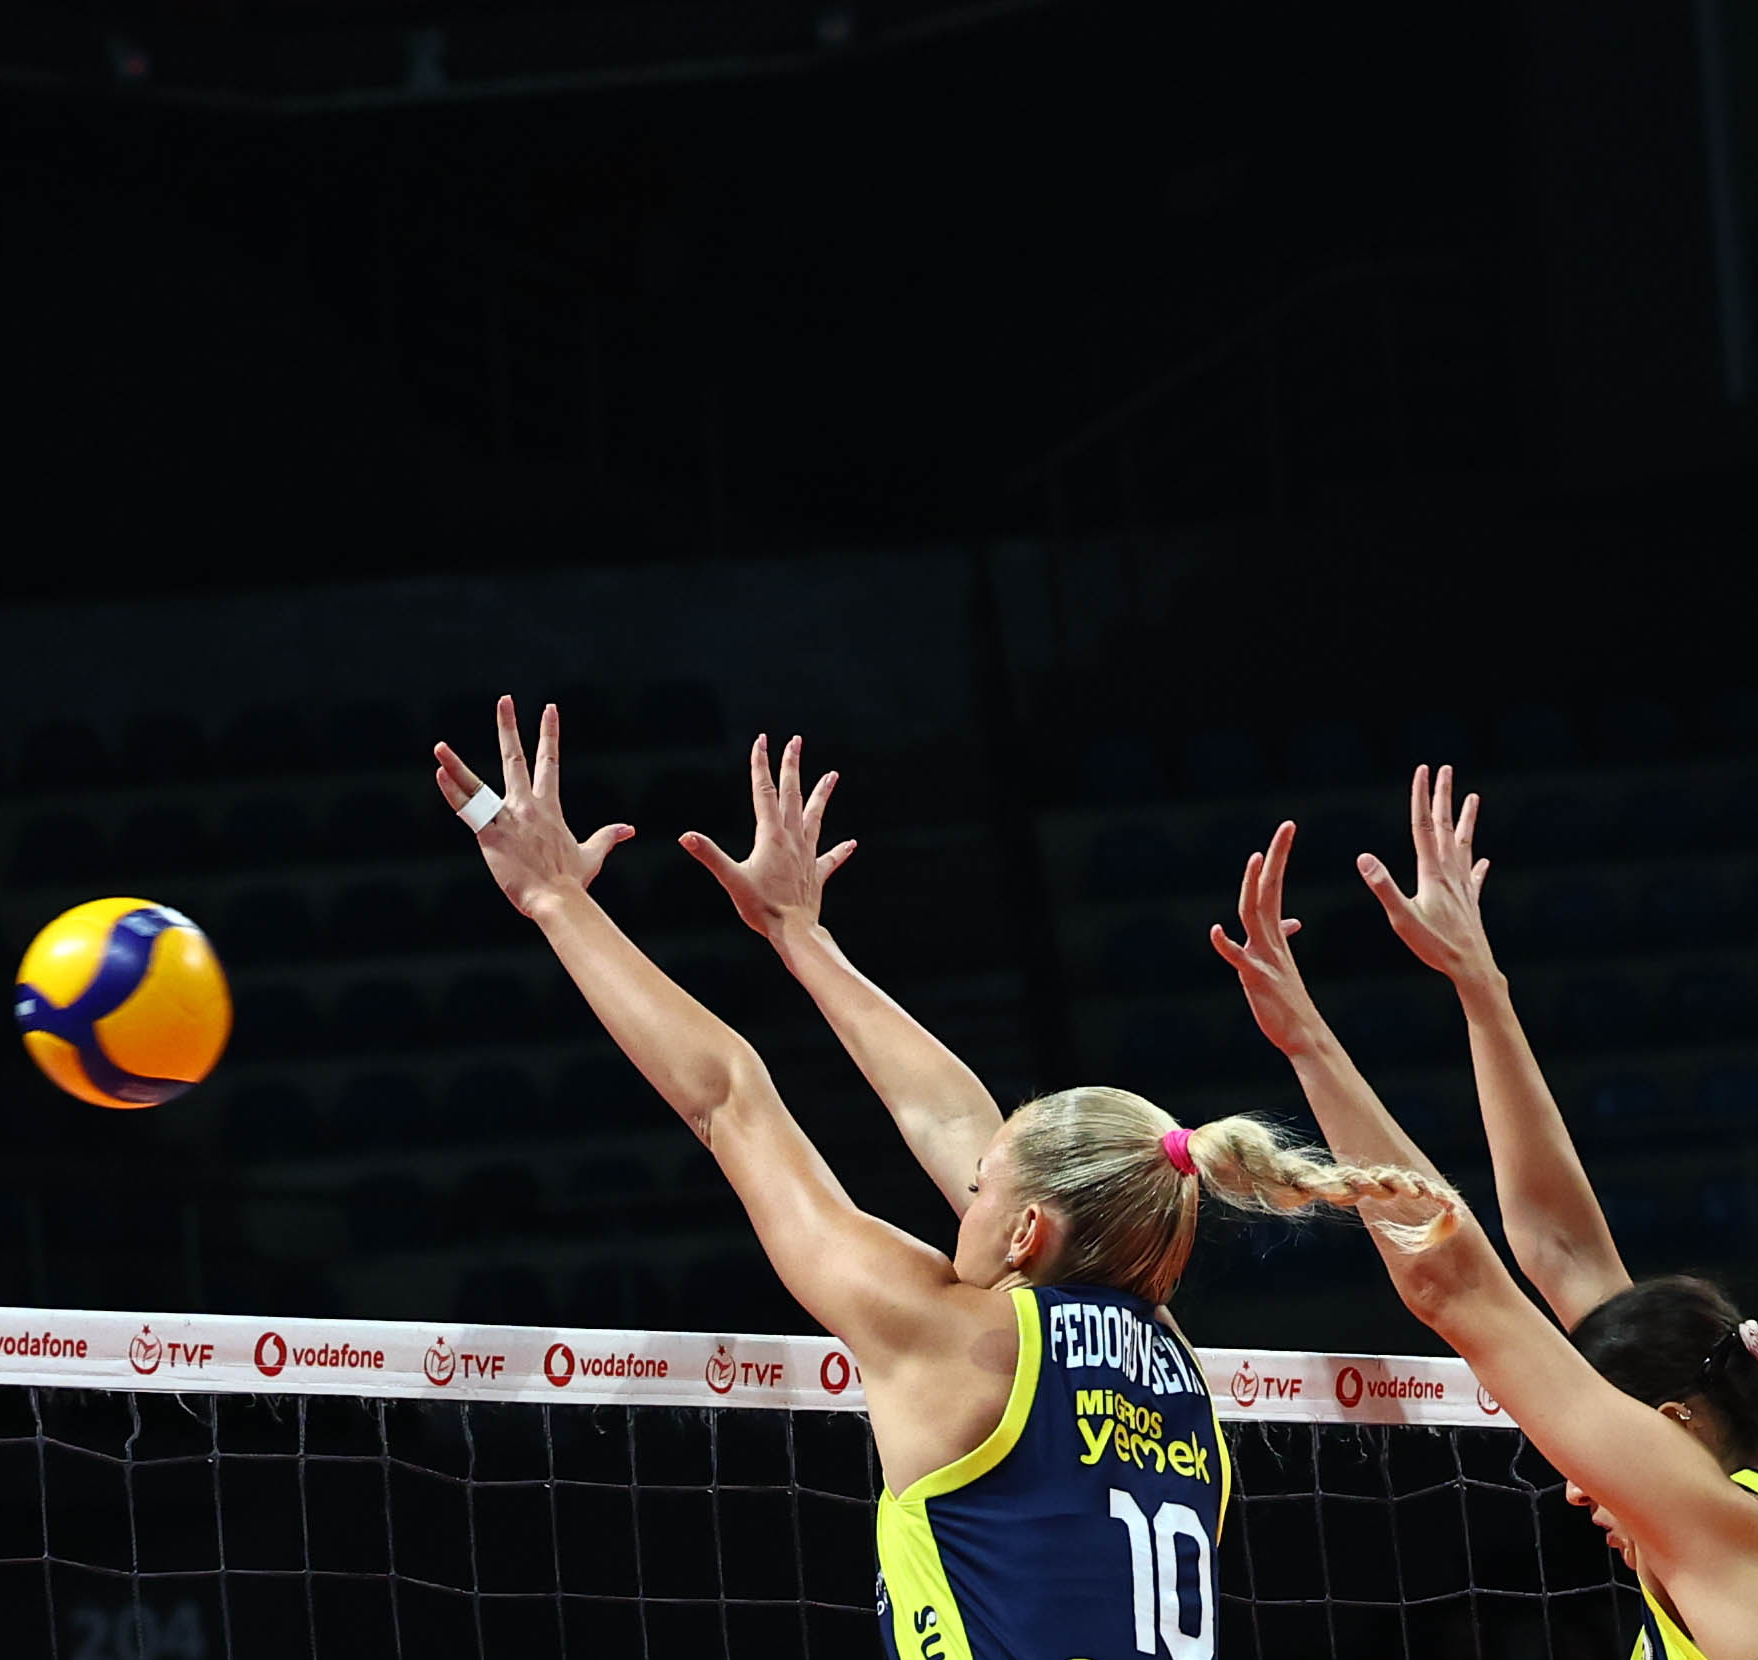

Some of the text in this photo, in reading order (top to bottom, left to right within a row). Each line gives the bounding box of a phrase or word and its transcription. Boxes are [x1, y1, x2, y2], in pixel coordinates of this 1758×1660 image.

[167, 1342, 214, 1364] TVF
[289, 1342, 385, 1368] vodafone
[578, 1352, 670, 1377] vodafone
[461, 1353, 506, 1378] TVF
[740, 1362, 785, 1386] TVF
[1259, 1376, 1304, 1397] TVF
[1368, 1376, 1442, 1398] vodafone
